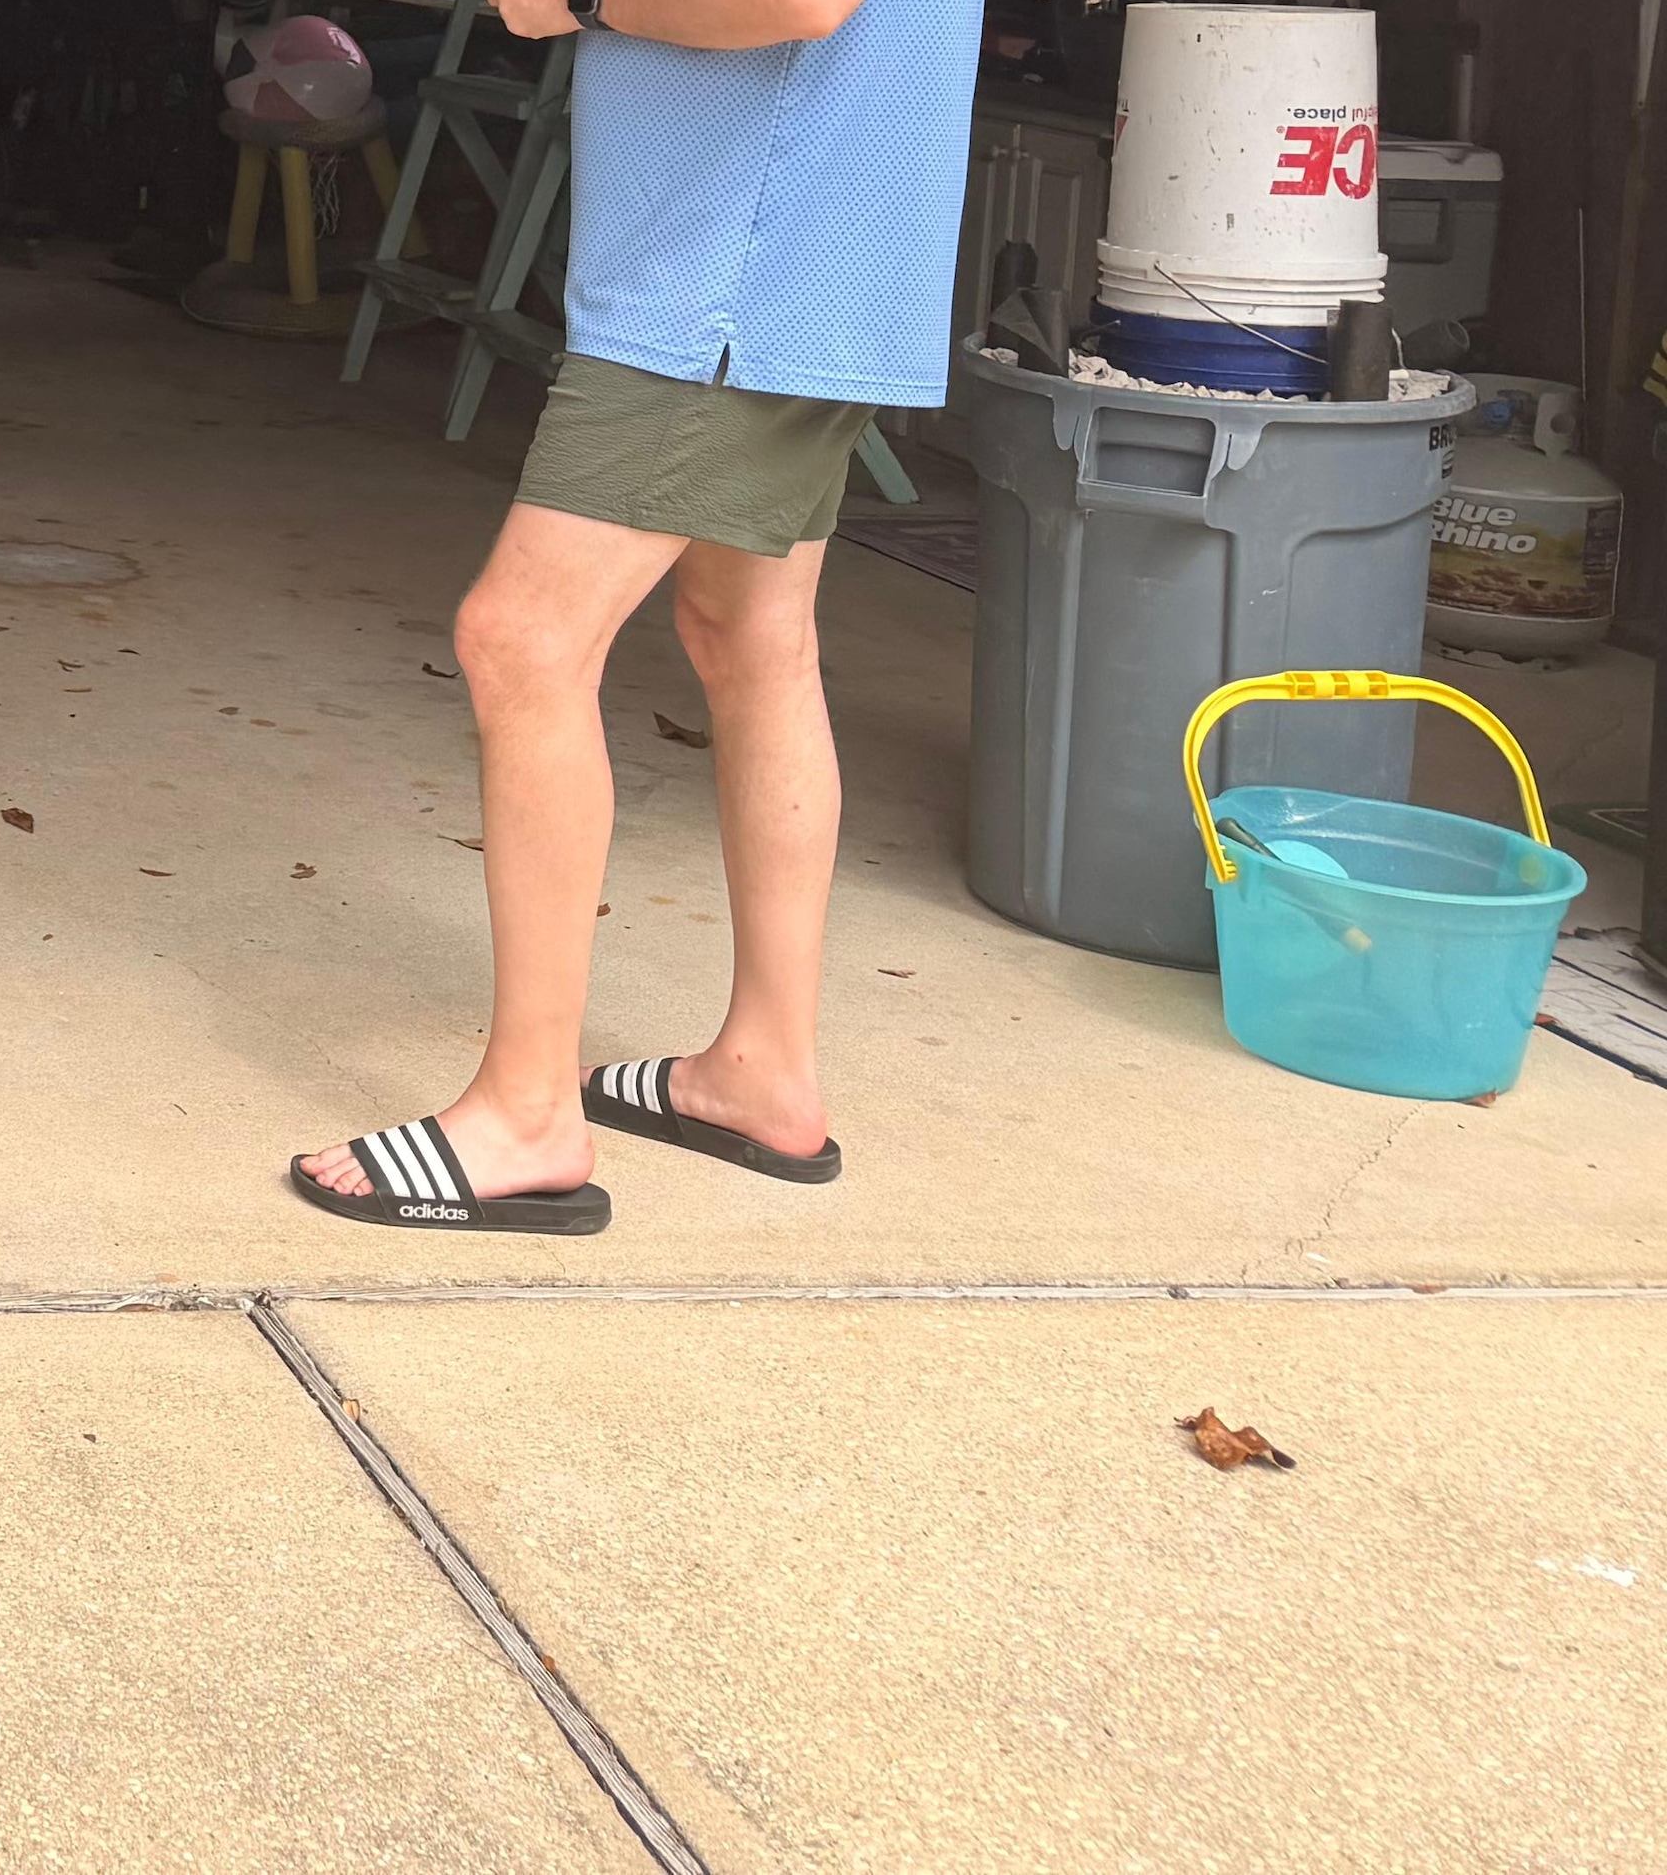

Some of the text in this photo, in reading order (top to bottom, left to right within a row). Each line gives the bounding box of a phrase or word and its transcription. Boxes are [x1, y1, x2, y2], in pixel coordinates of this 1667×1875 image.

[1287, 105, 1347, 123] place.
[1270, 124, 1378, 200] CE
[1432, 497, 1516, 527] Blue
[399, 1203, 470, 1221] adidas
